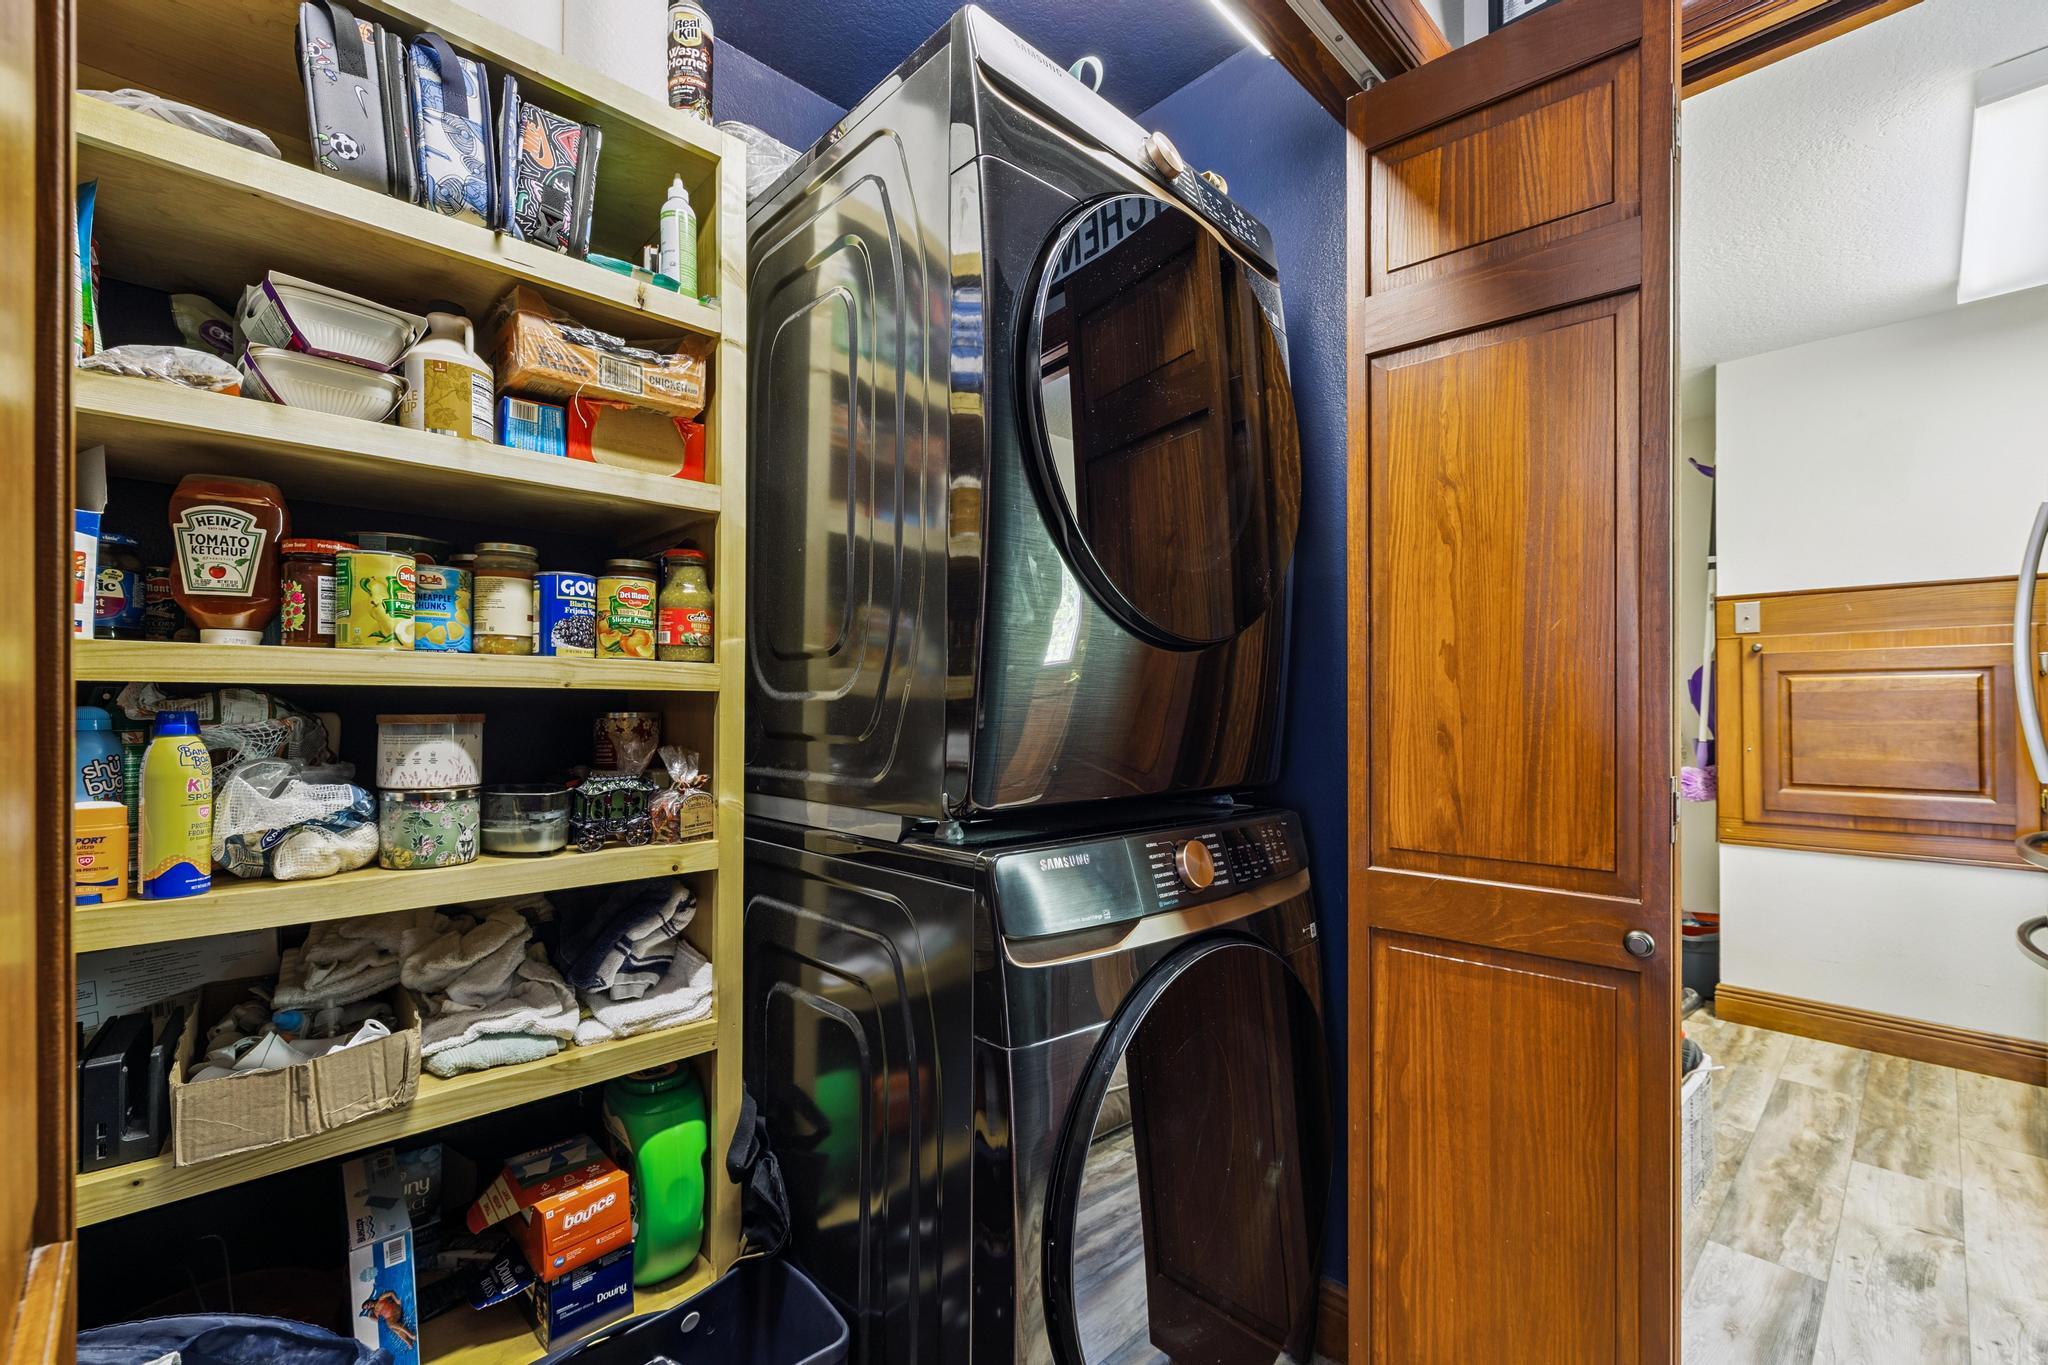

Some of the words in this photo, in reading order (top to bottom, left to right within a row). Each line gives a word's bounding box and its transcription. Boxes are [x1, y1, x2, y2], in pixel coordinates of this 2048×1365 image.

[675, 19, 700, 30] Real
[679, 28, 698, 40] Kill
[669, 46, 700, 59] Wasp
[668, 57, 708, 72] Hornet
[649, 375, 688, 393] CHICKEN
[196, 516, 242, 529] HEINZ
[187, 533, 250, 548] TOMATO
[191, 545, 247, 557] KETCHUP
[419, 574, 442, 585] Dole
[560, 579, 595, 597] GOY
[620, 591, 631, 599] Del
[631, 592, 650, 600] Monte
[564, 607, 588, 615] Frijoles
[570, 600, 587, 608] Black
[83, 754, 121, 779] shü
[85, 776, 123, 796] bug
[1040, 853, 1090, 871] SAMSUNG
[563, 1192, 617, 1230] bounce
[495, 1258, 519, 1295] Downy
[597, 1282, 627, 1303] Downy
